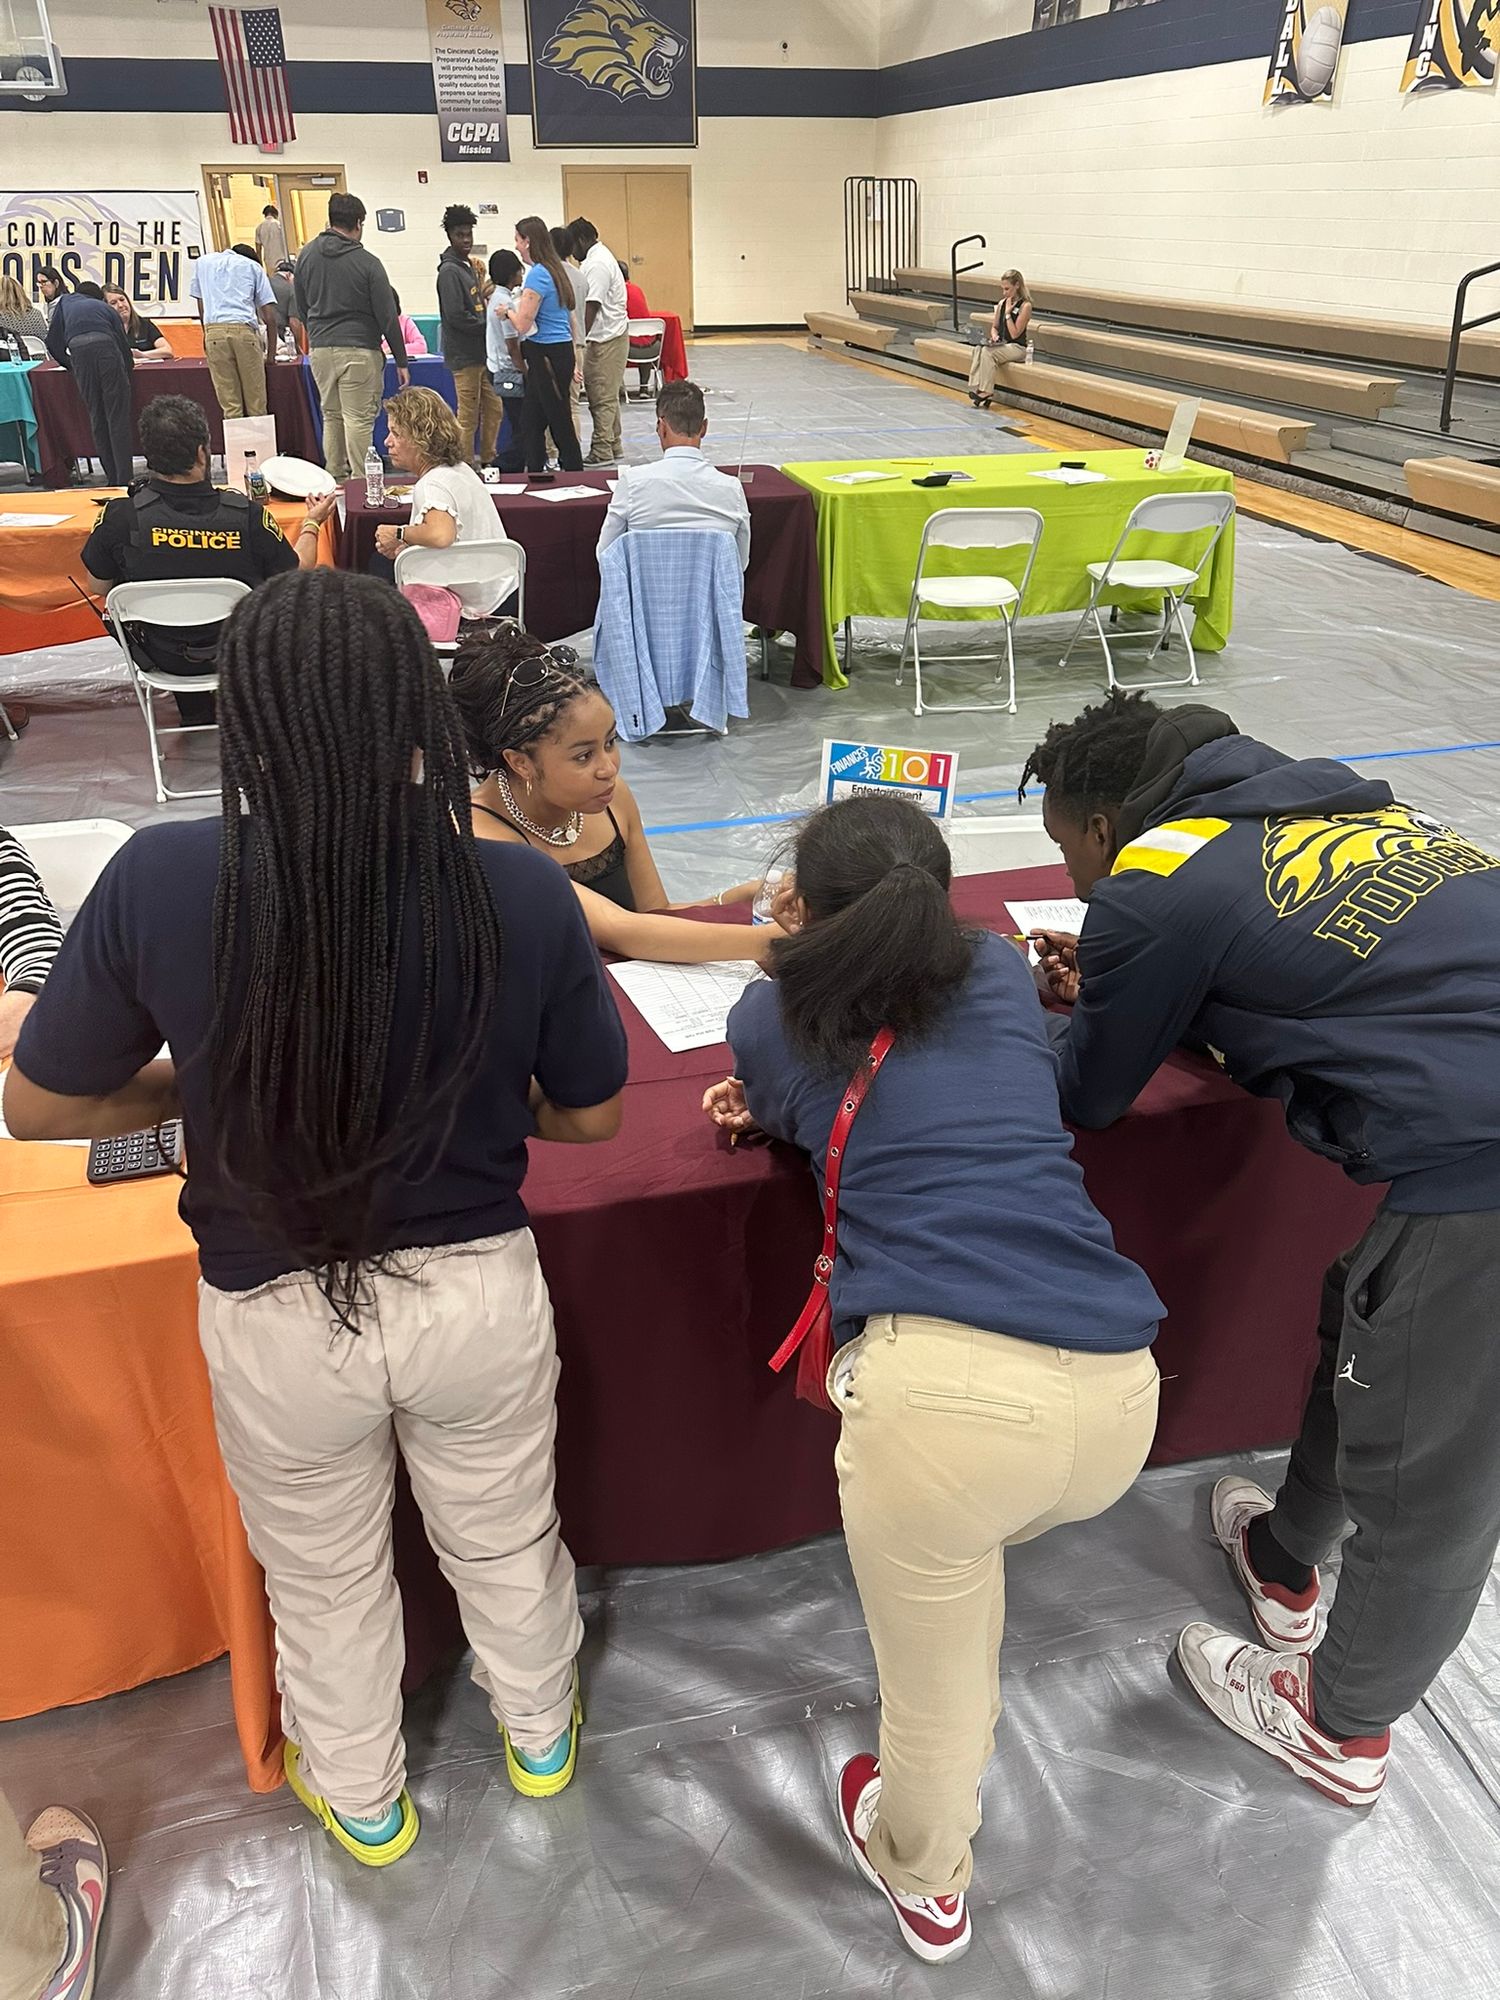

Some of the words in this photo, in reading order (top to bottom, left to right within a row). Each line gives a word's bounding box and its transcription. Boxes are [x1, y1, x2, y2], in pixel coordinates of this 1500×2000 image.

[436, 56, 471, 64] Preparatory
[447, 122, 500, 142] CCPA
[458, 145, 492, 154] Mission
[92, 220, 119, 246] TO
[137, 220, 181, 246] THE
[104, 251, 180, 301] DEN
[151, 527, 240, 537] CINCINNATI
[152, 532, 241, 549] POLICE
[830, 745, 869, 776] FINANCES
[888, 752, 946, 785] 101
[851, 784, 923, 801] Entertainment
[1229, 1678, 1246, 1693] 550
